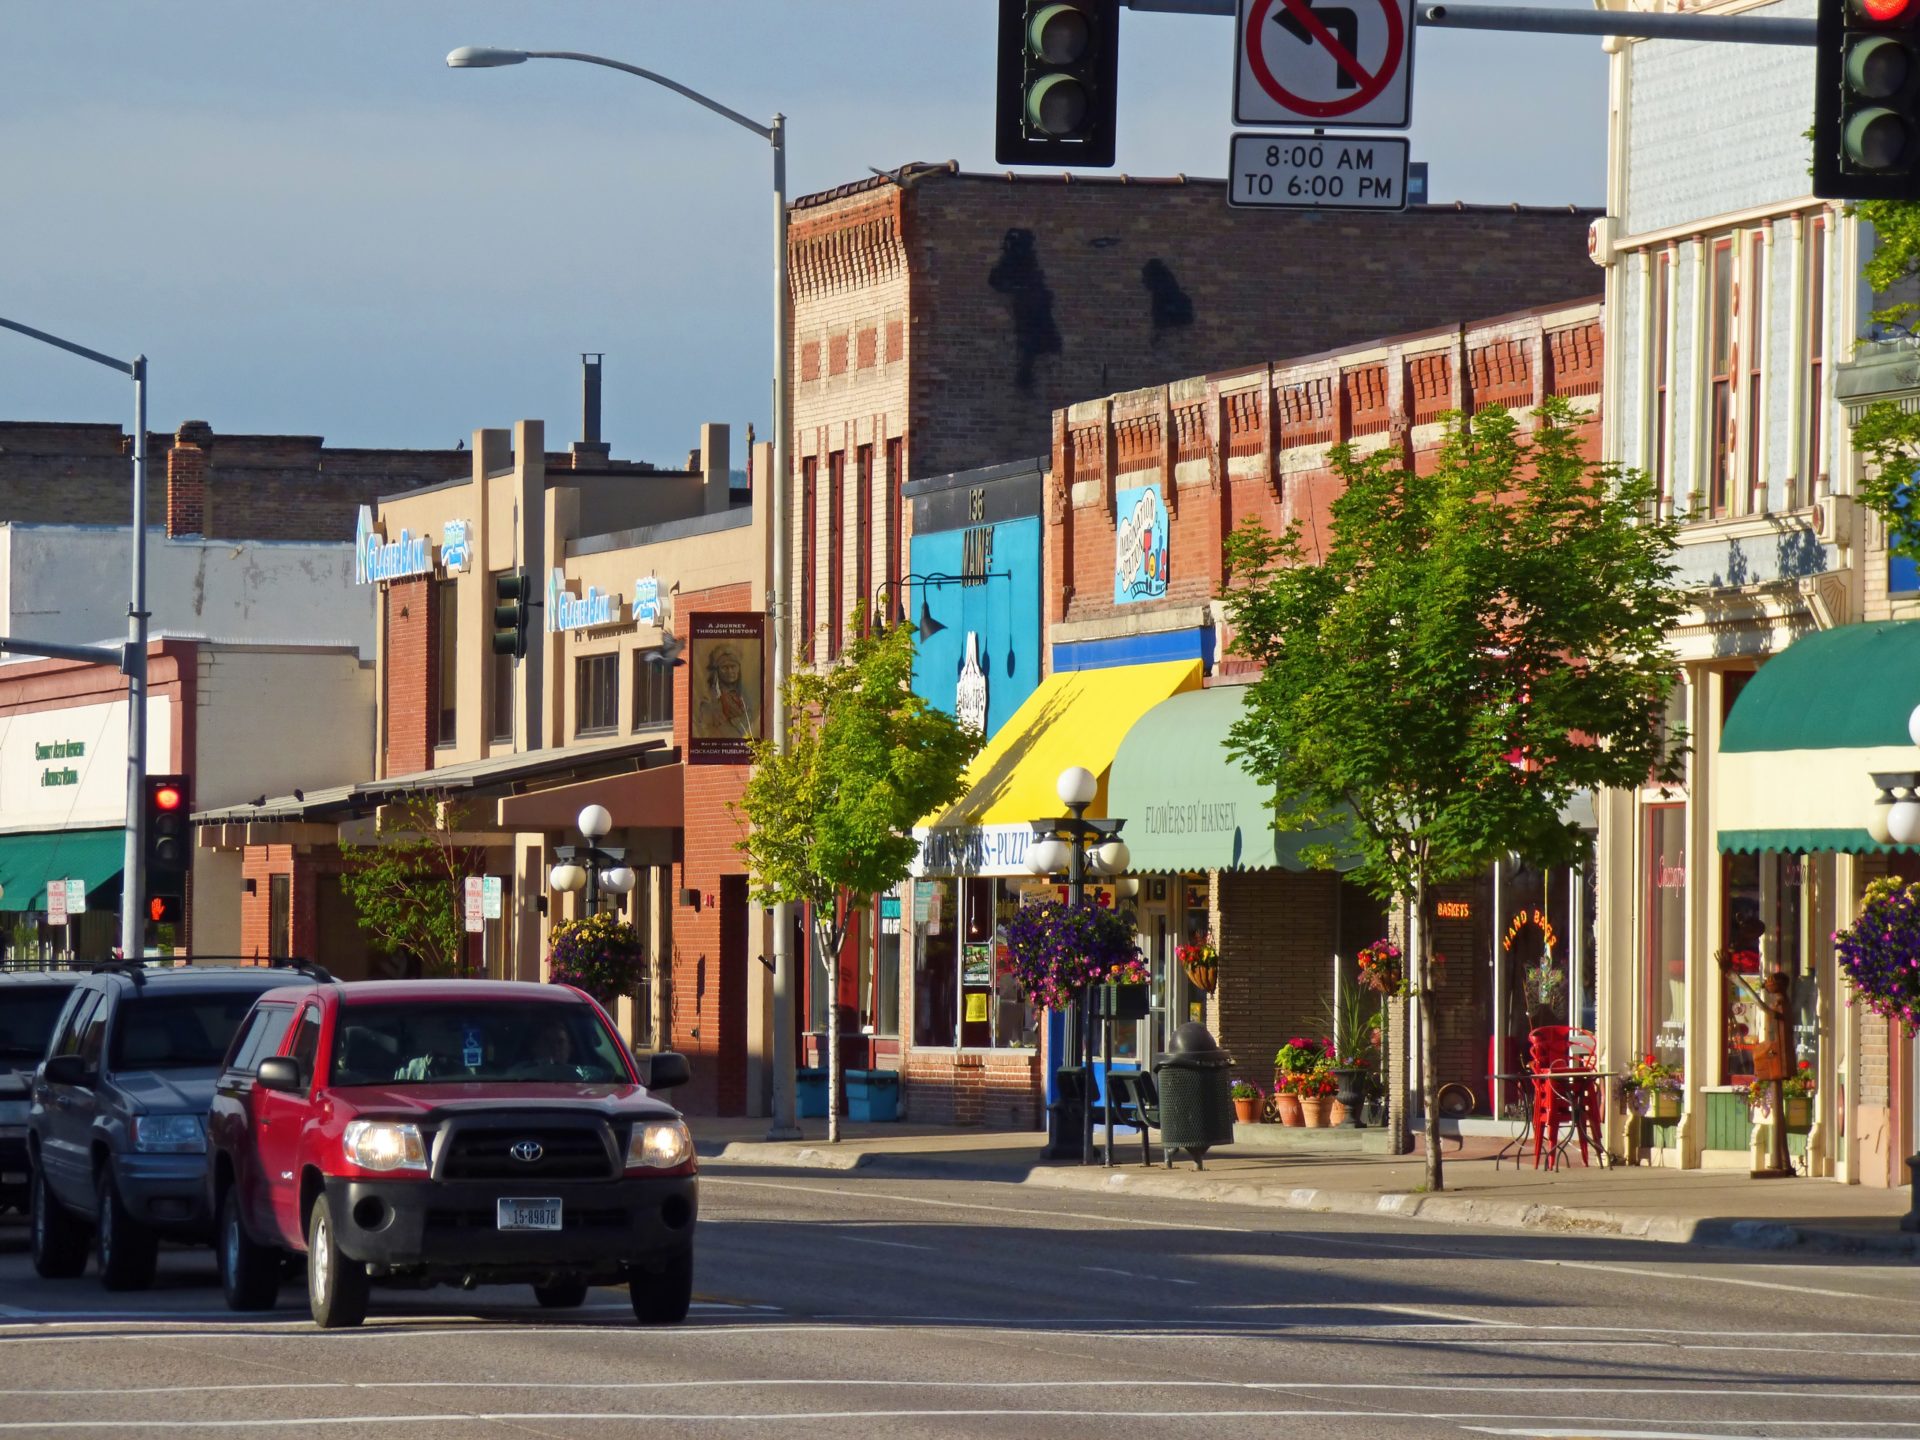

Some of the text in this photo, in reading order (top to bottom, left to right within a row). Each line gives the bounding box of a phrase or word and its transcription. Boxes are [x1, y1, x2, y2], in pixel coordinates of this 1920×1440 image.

[1265, 145, 1374, 170] 8:00 AM
[1245, 173, 1392, 199] TO 6:00 PM
[968, 488, 984, 521] 136
[962, 527, 987, 588] MAIN
[1145, 798, 1237, 834] FLOWERS BY HANSEN
[1437, 902, 1469, 918] BASKETS
[1502, 909, 1557, 951] HAND BAGS
